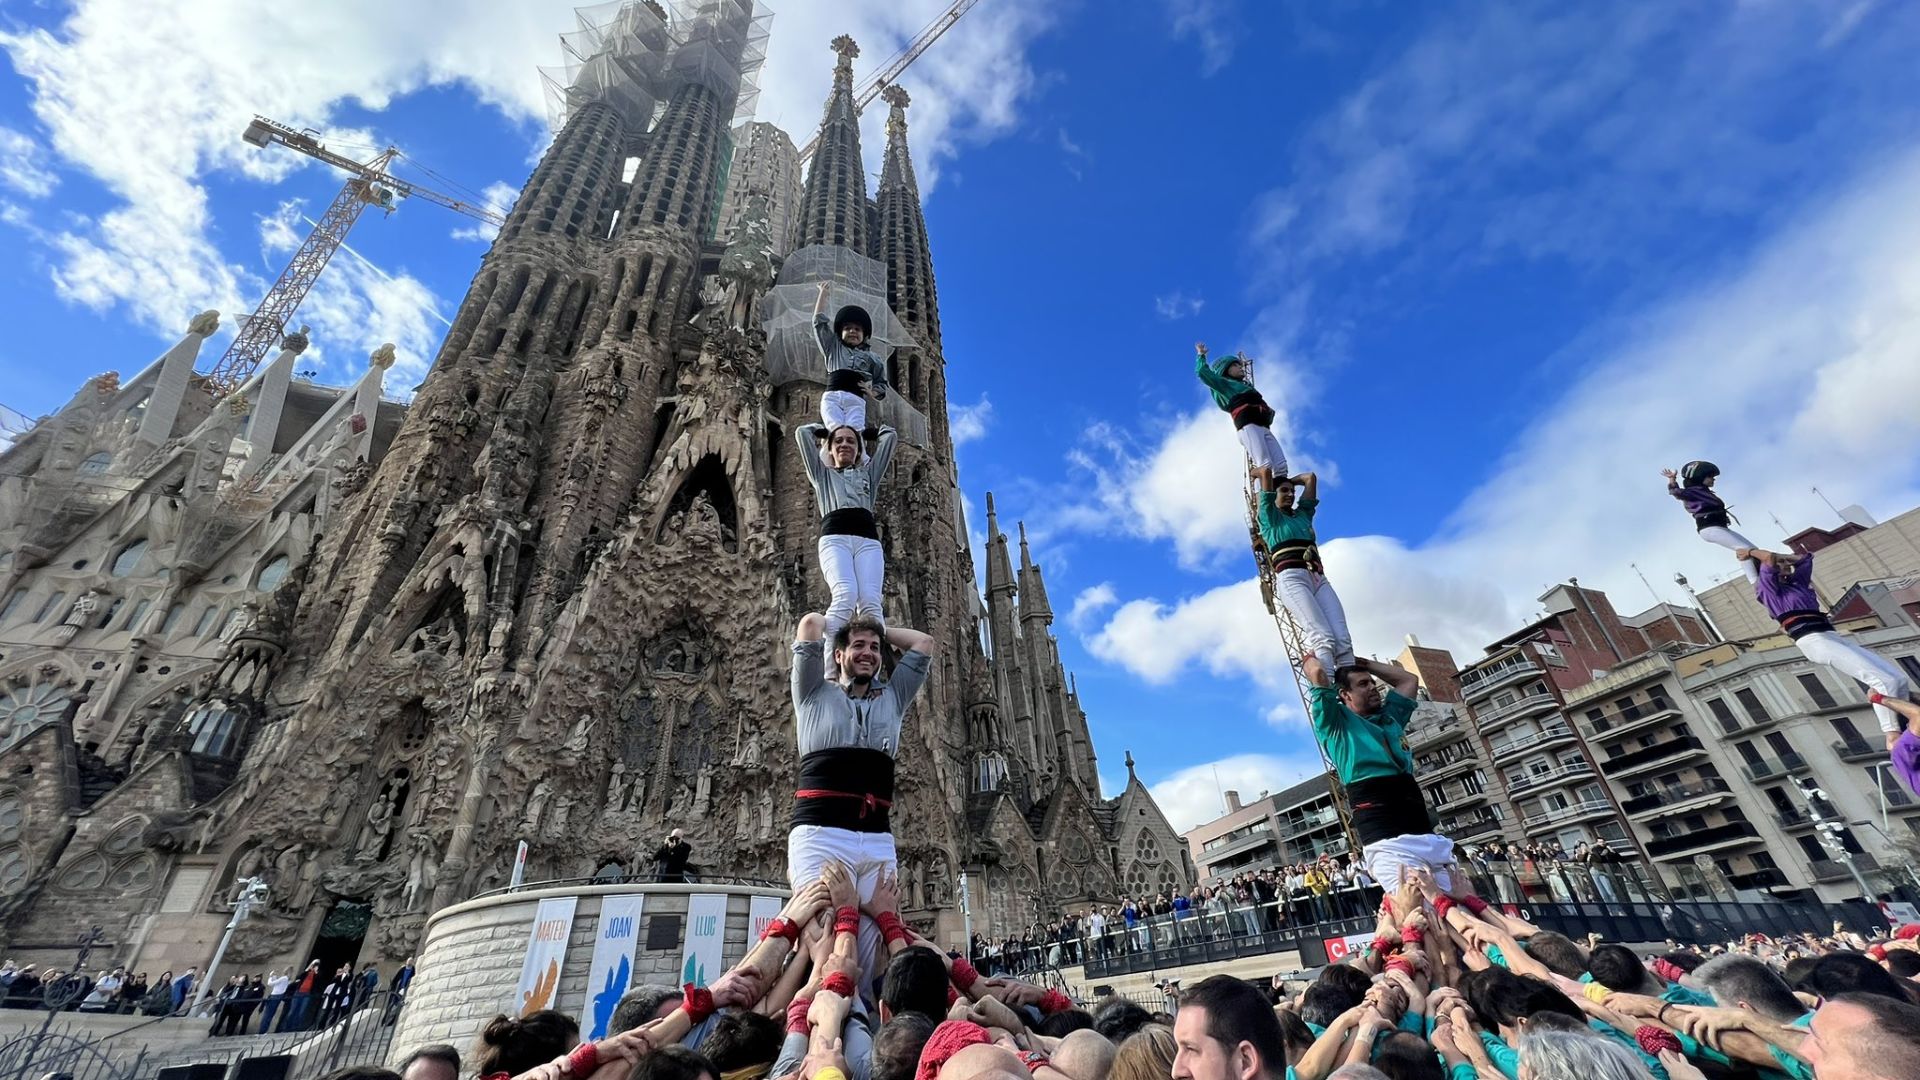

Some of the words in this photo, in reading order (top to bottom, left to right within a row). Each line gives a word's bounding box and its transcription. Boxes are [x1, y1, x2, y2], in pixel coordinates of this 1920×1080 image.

[253, 113, 296, 133] POTAIN
[536, 919, 567, 942] MATEU
[604, 916, 632, 939] JOAN
[695, 915, 717, 937] LLUC
[1331, 942, 1344, 958] C
